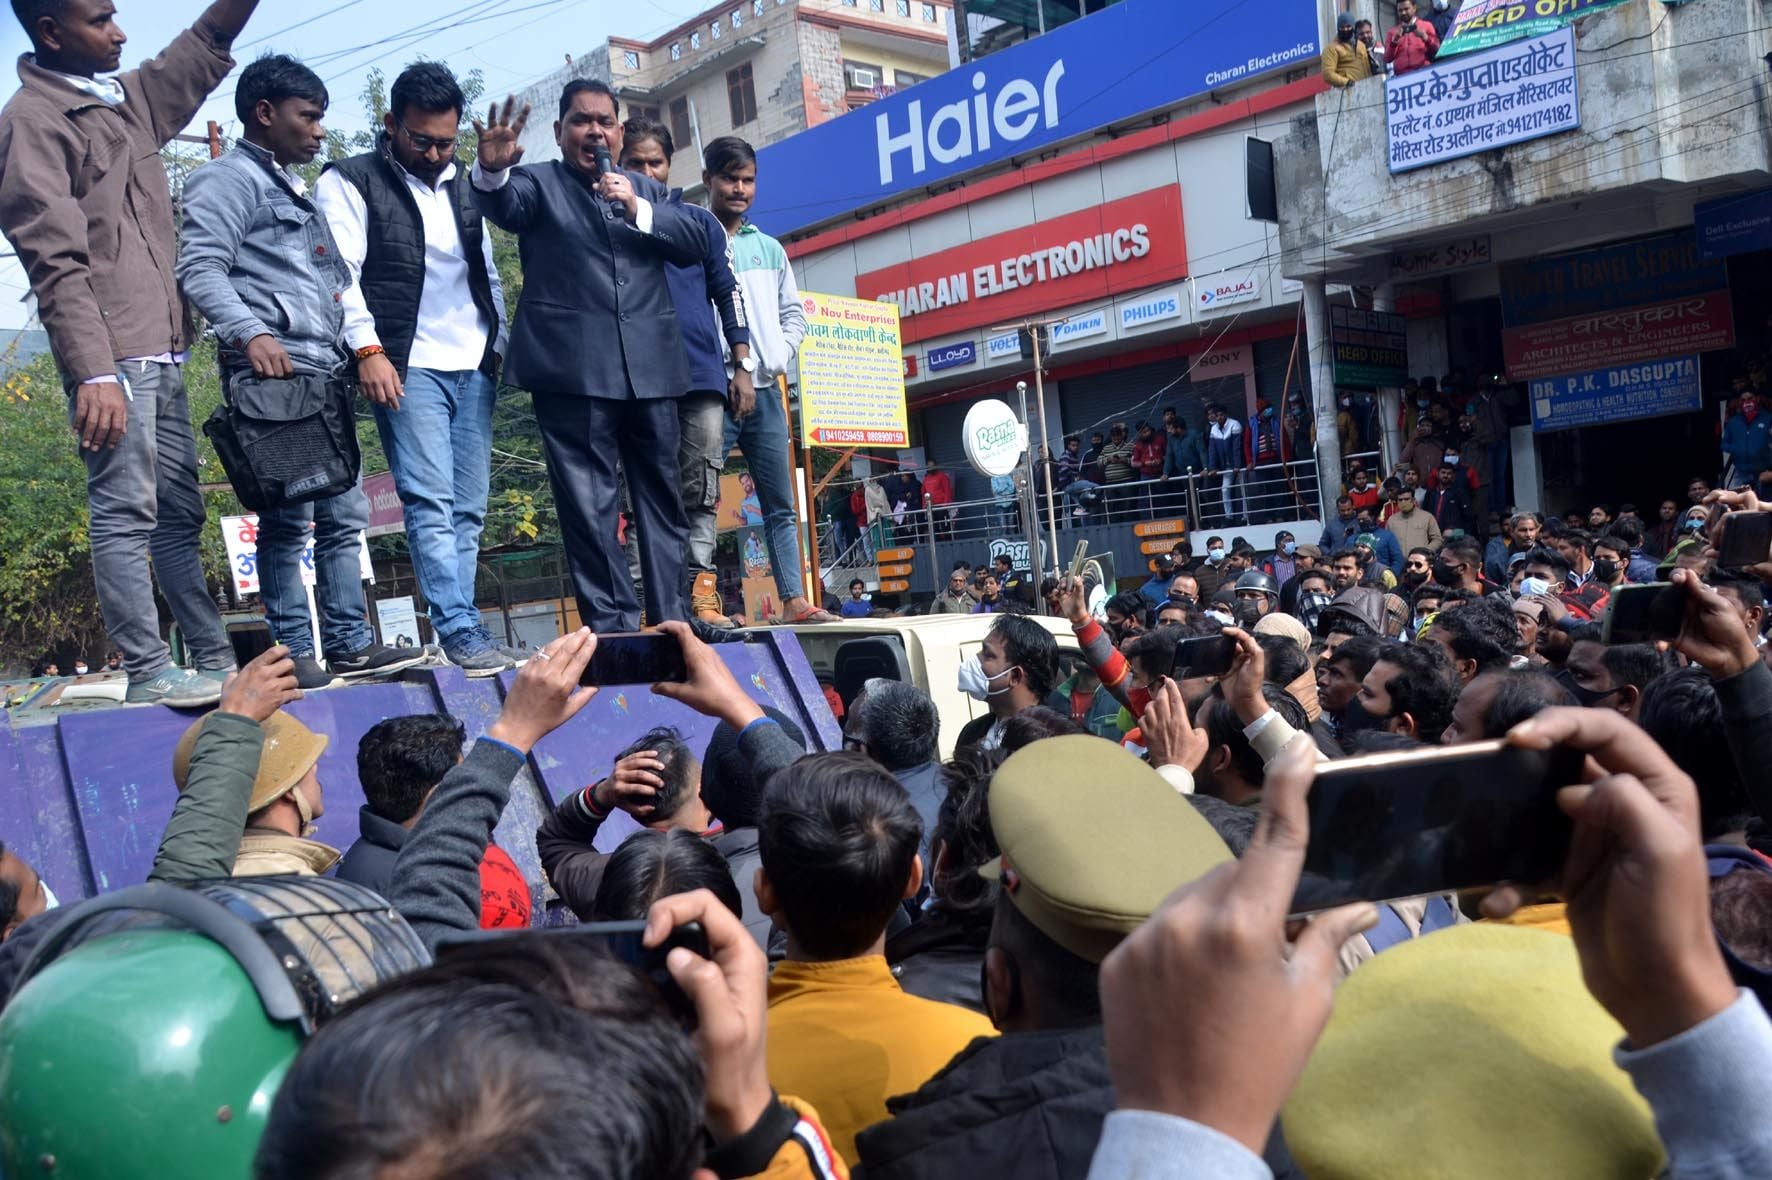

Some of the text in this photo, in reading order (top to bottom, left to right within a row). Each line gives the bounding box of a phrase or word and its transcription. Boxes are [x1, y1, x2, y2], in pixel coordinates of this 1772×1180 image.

[1205, 42, 1315, 85] Charan Electronics
[1500, 40, 1568, 83] एडवोकेट
[875, 58, 1065, 186] Haier
[1444, 103, 1476, 127] प्रथम
[1391, 139, 1423, 162] मैरिस
[1424, 133, 1444, 156] रोड
[1704, 225, 1724, 236] Dell
[972, 223, 1151, 299] ELECTRONICS
[1446, 239, 1488, 265] Style
[1634, 241, 1720, 280] SERVIC
[1216, 281, 1252, 295] BAJAJ
[843, 309, 896, 326] Enterprises
[1123, 298, 1176, 322] PHILIPS
[1572, 298, 1707, 335] वास्तुकार
[1063, 318, 1101, 334] DAIKIN
[990, 335, 1021, 352] VOLT
[1337, 345, 1367, 361] HEAD
[1522, 339, 1608, 361] ARCHITECTS
[1627, 319, 1712, 344] ENGINEERS
[930, 346, 970, 365] LLOYD
[1199, 351, 1241, 367] SONY
[1532, 381, 1560, 399] DR.
[1567, 374, 1601, 394] P.K.
[1607, 359, 1695, 388] DASGUPTA
[976, 419, 1015, 450] Rasna
